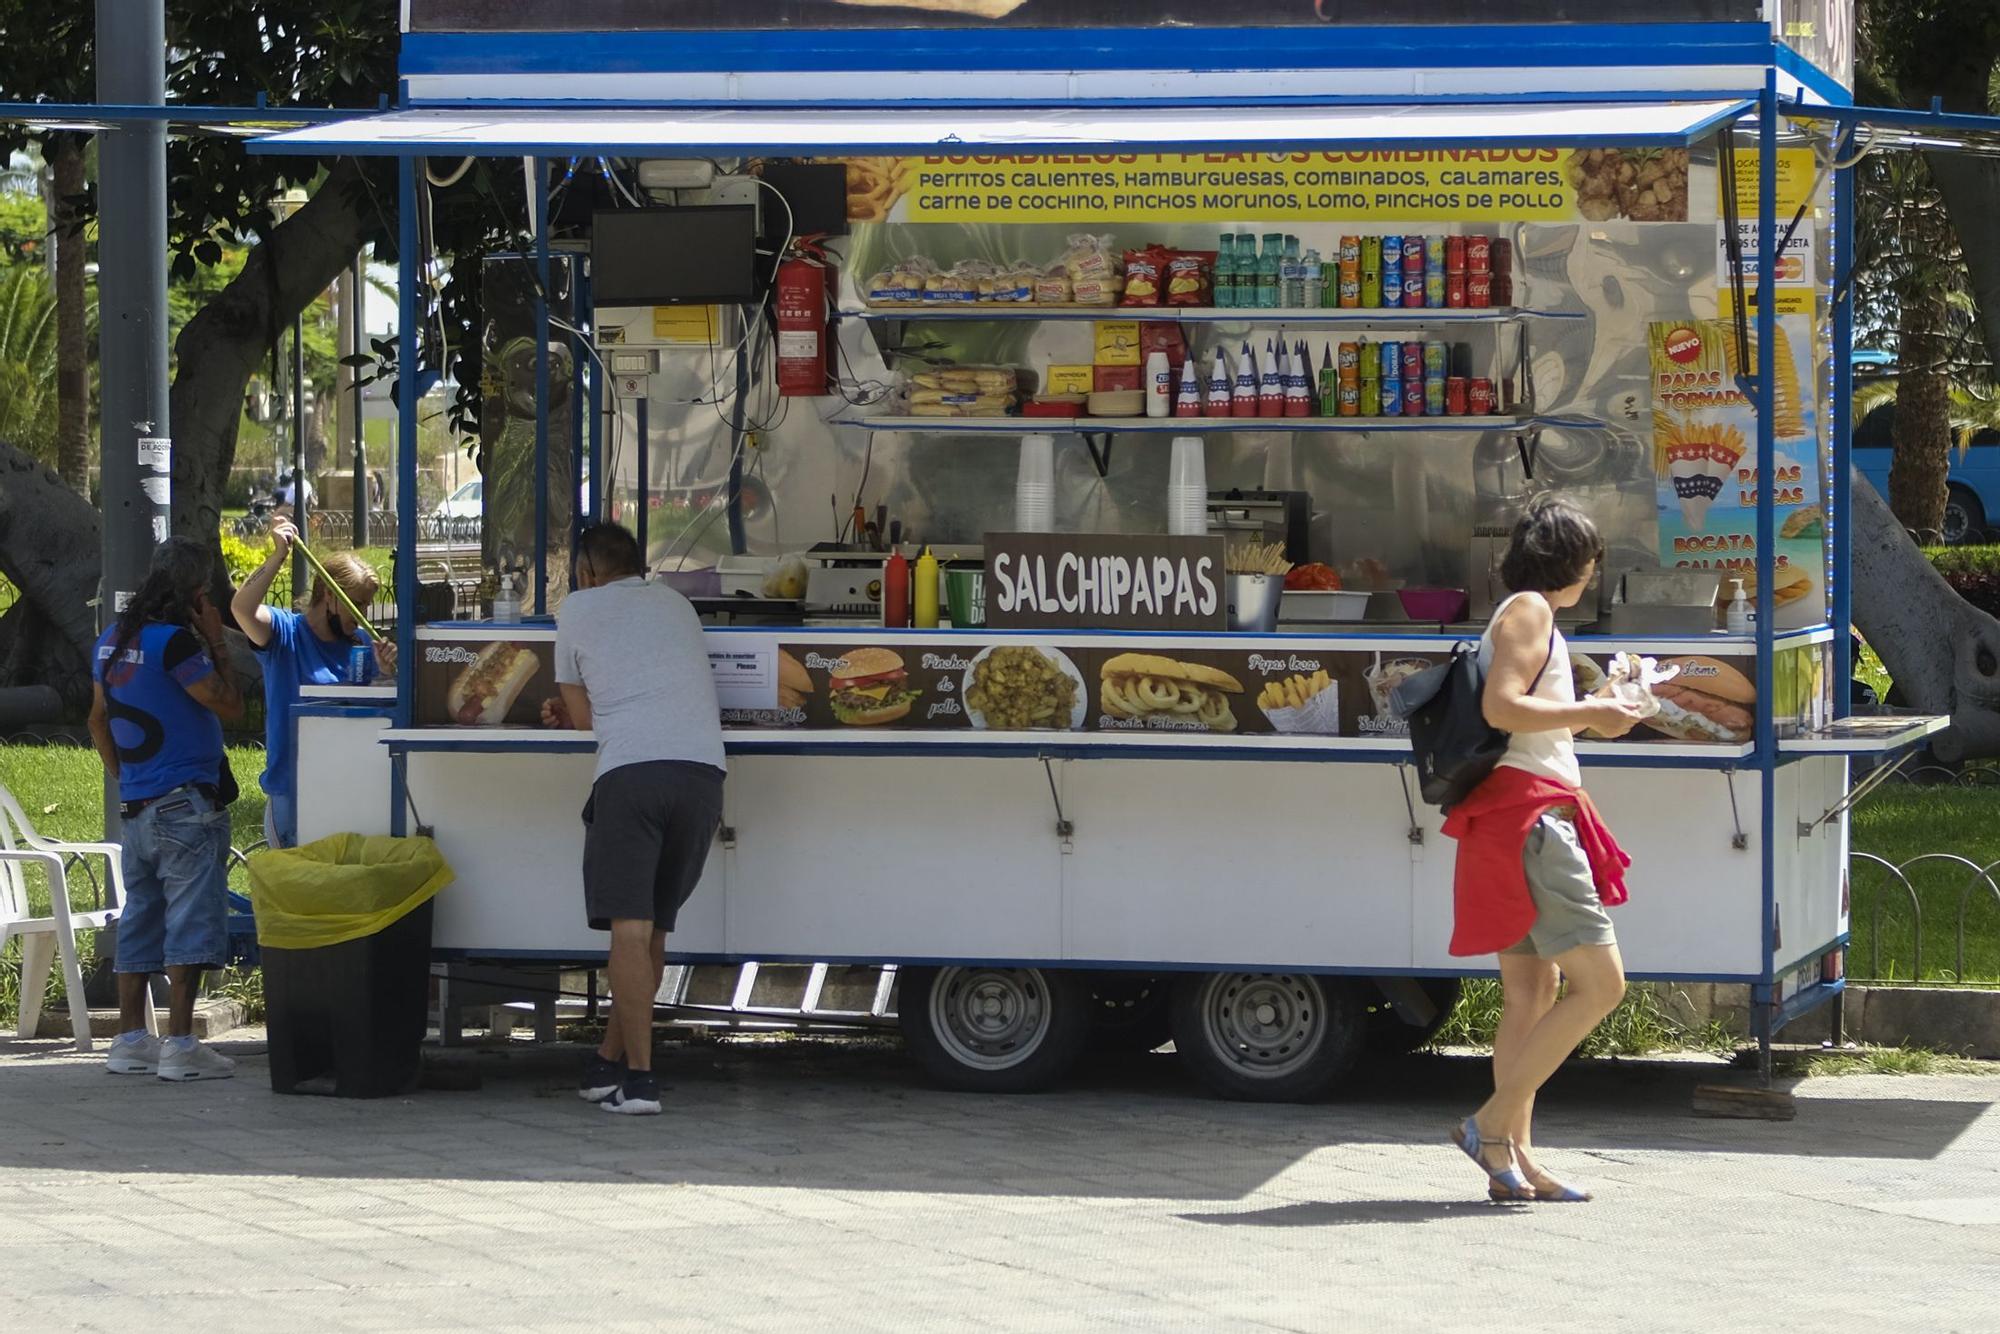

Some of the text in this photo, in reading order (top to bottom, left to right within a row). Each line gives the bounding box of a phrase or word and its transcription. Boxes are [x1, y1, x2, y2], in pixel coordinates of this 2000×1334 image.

[1667, 337, 1701, 355] NUEVO
[1660, 371, 1721, 388] PAPAS
[994, 551, 1217, 616] SALCHIPAPAS
[425, 646, 480, 668] Hot-Dog
[922, 652, 970, 671] Pinchos
[1248, 653, 1321, 676] Papas locas
[936, 675, 955, 692] de
[927, 697, 961, 720] pollo
